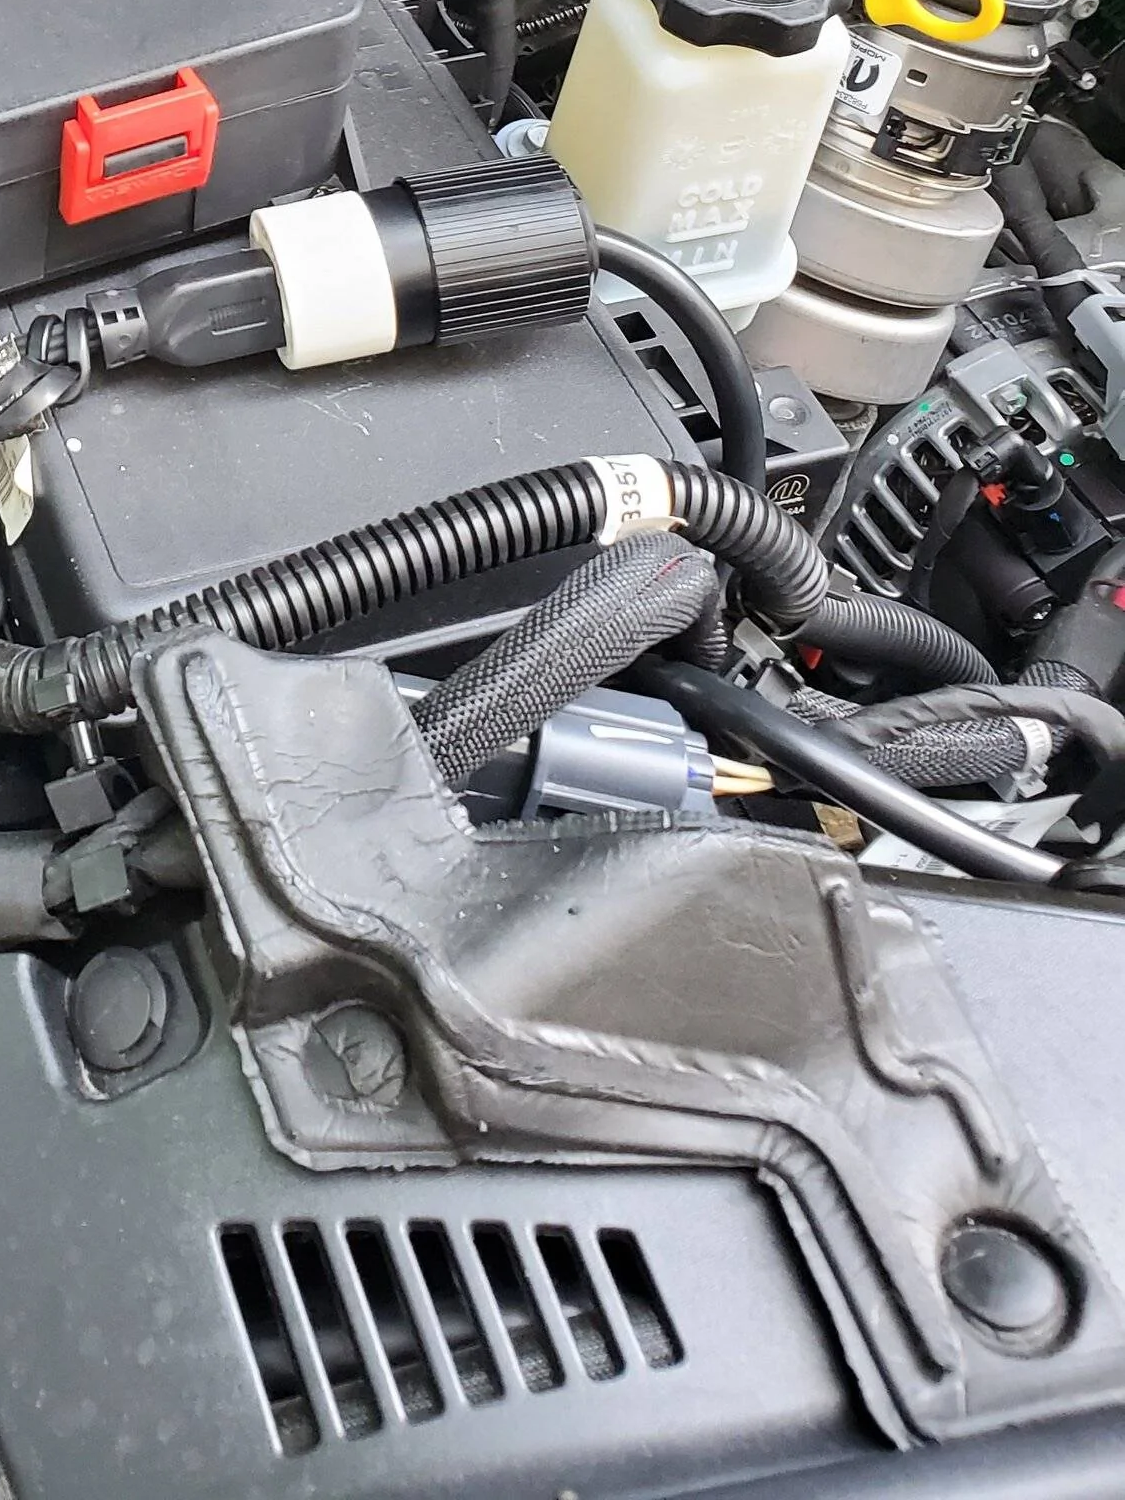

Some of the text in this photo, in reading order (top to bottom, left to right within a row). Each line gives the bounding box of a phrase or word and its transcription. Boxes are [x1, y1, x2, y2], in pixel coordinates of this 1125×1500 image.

[850, 40, 887, 63] MOPA
[677, 174, 763, 208] COLD
[668, 199, 755, 233] MAX
